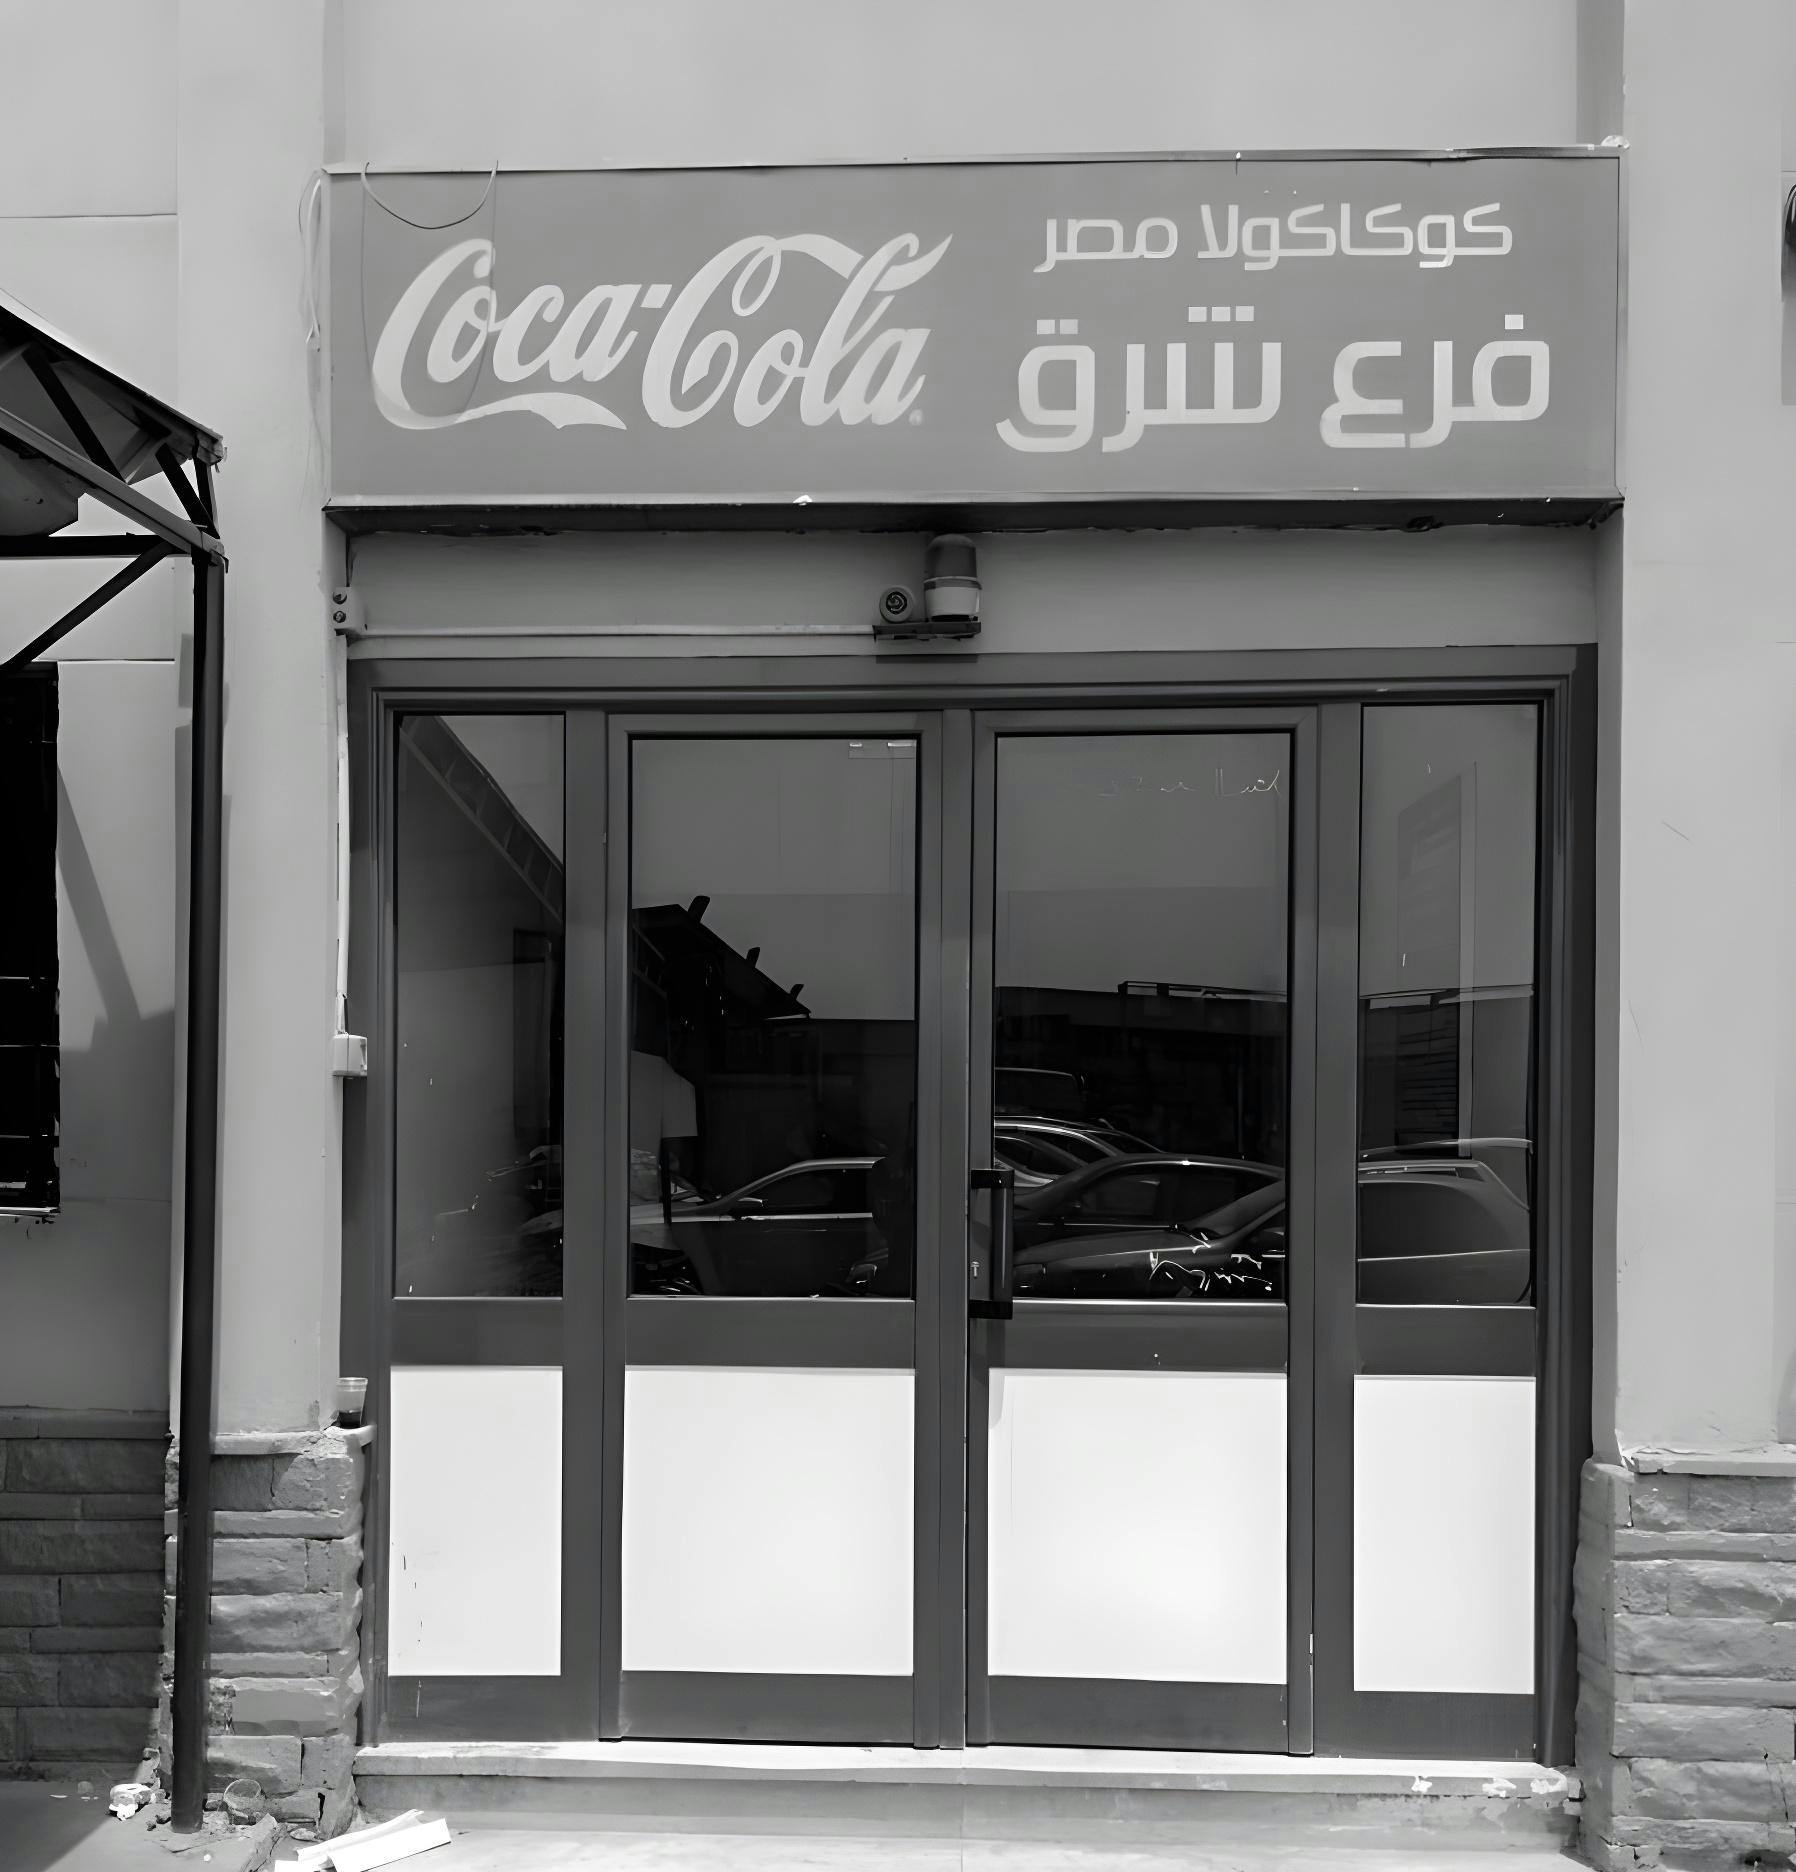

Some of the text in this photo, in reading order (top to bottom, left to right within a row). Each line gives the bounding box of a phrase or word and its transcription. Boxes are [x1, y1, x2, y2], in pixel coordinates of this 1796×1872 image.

[1033, 202, 1514, 273] كوكاكولا مصر
[372, 232, 953, 430] Coca-Cola
[995, 305, 1550, 453] فرع شرق
